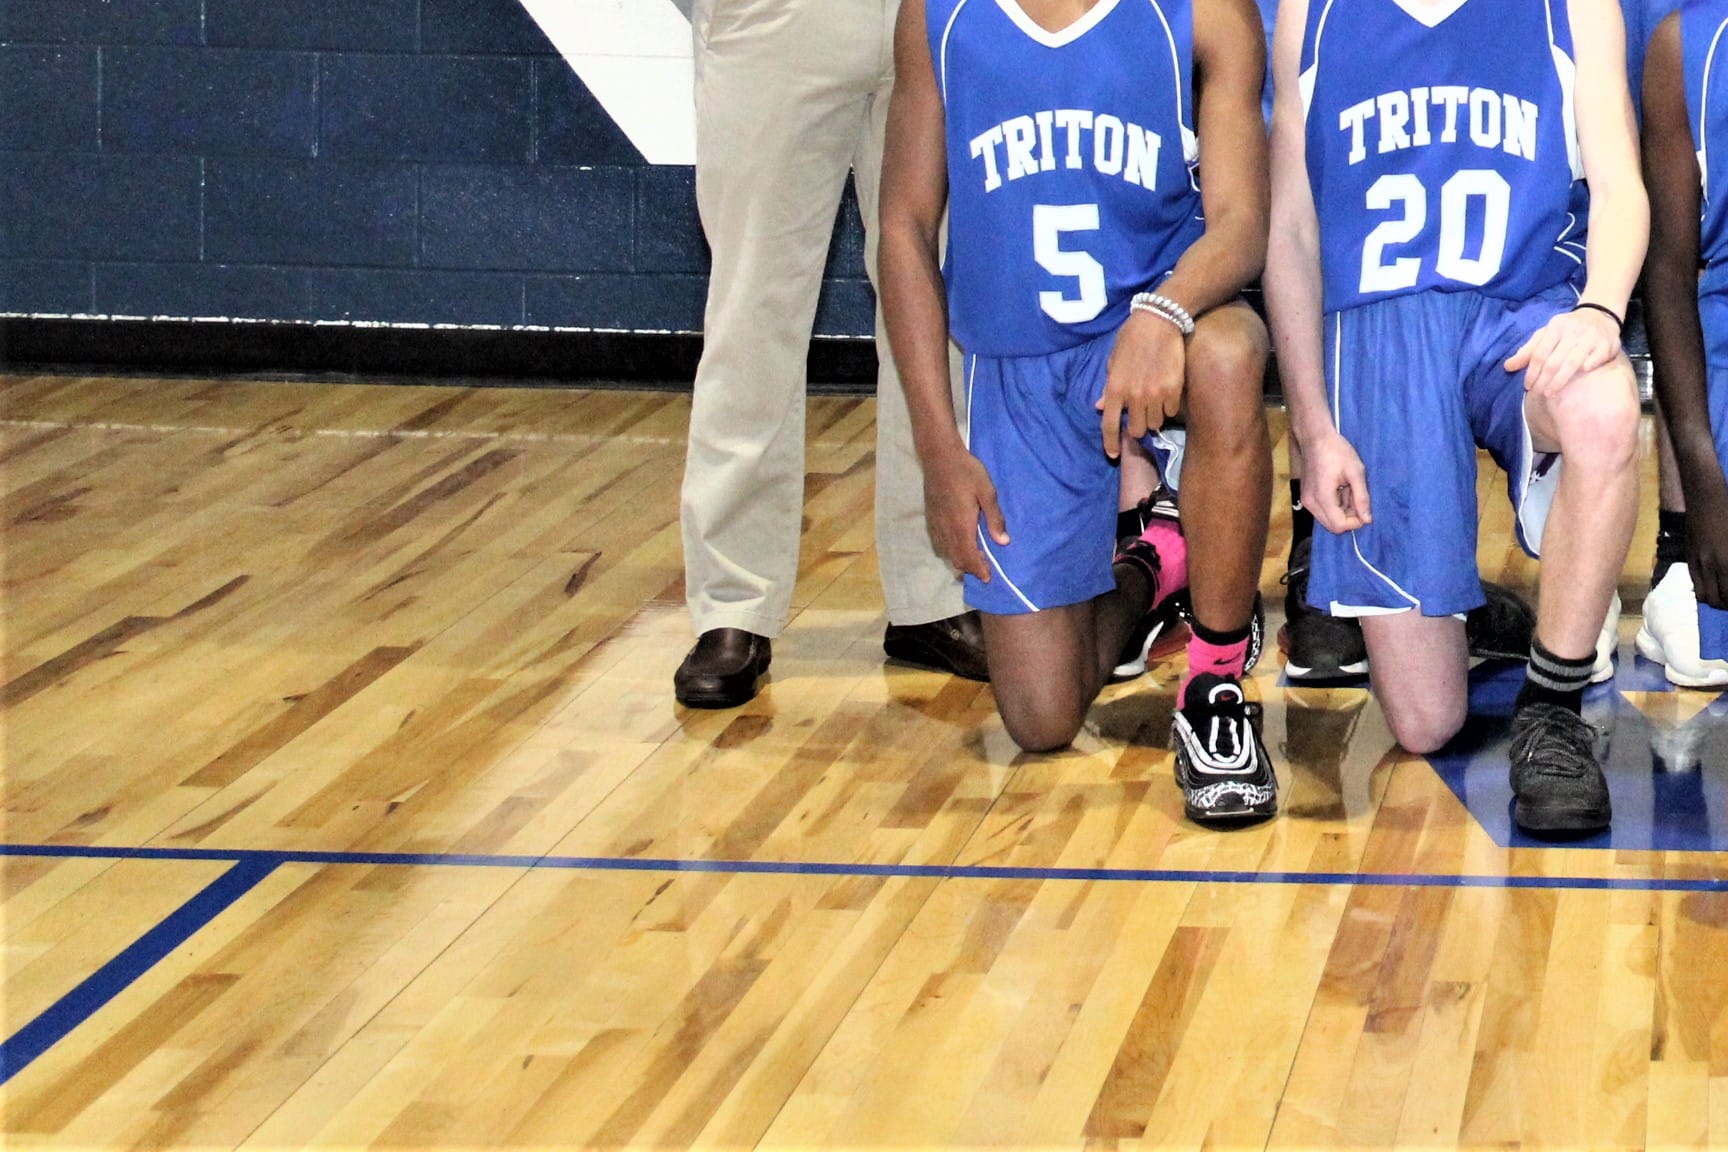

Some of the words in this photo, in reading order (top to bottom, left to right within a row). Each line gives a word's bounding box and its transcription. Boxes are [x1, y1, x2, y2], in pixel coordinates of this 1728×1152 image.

[970, 110, 1161, 192] TRITON
[1340, 86, 1538, 165] TRITON
[1033, 204, 1107, 323] 5
[1359, 170, 1510, 293] 20
